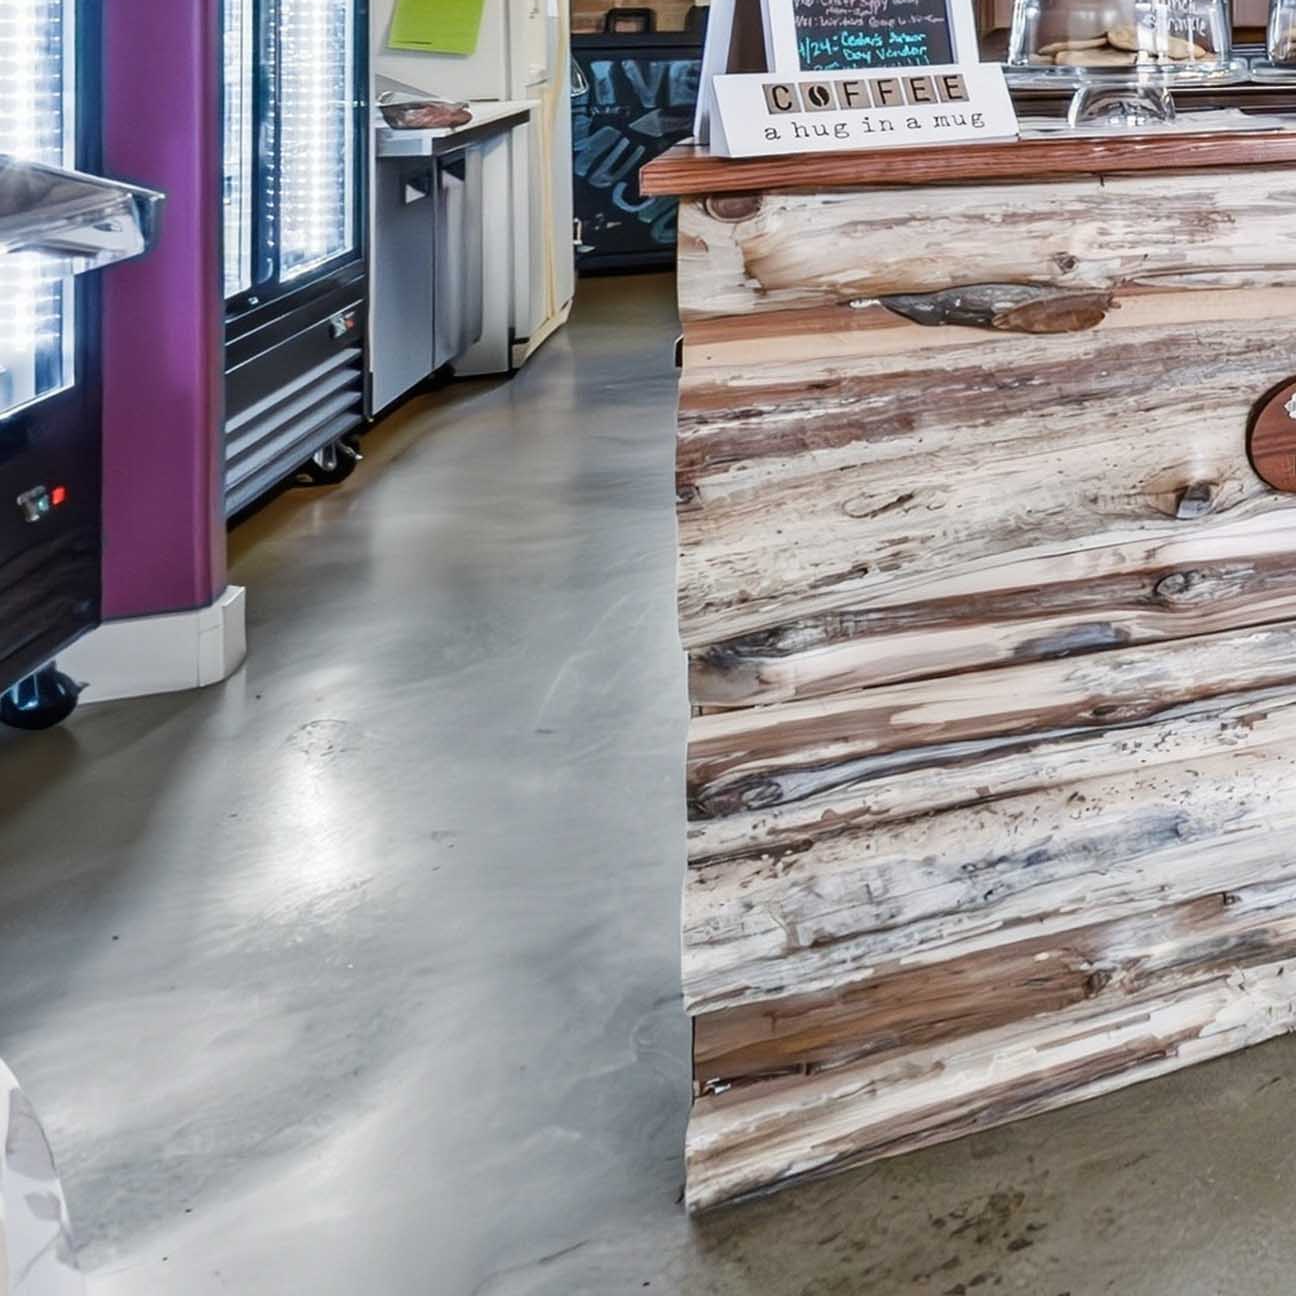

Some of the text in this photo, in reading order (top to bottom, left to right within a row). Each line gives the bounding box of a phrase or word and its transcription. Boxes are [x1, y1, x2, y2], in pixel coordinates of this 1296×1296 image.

[769, 74, 966, 112] COFFEE
[764, 110, 987, 142] a hug in a mug
